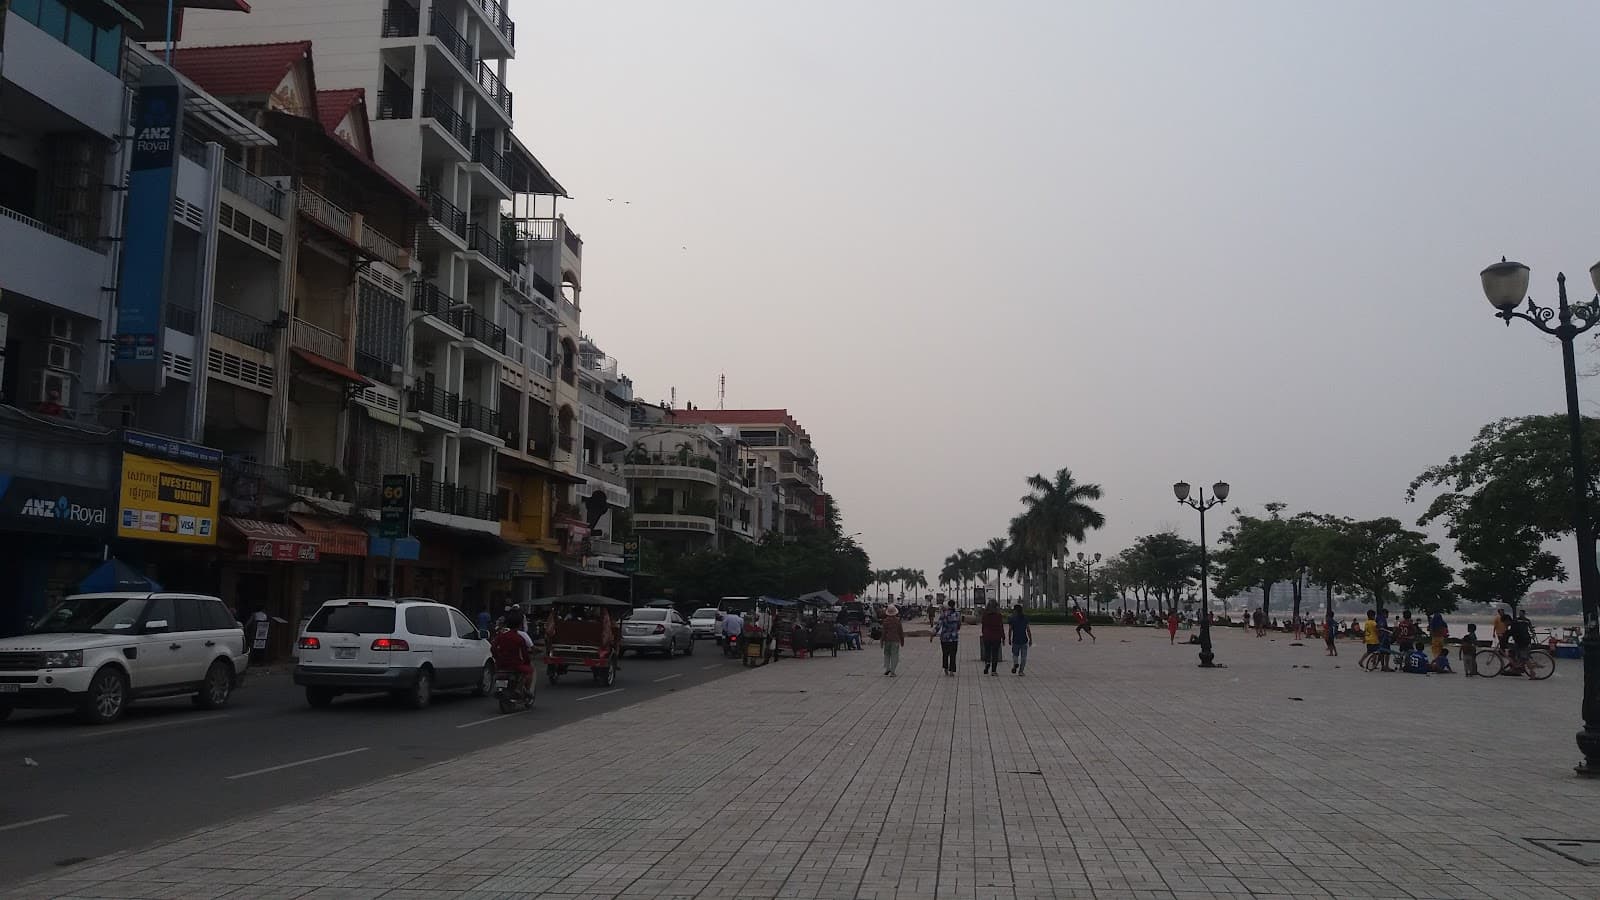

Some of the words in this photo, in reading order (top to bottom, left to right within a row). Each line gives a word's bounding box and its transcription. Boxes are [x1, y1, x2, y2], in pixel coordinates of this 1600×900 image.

[138, 127, 171, 139] ANZ
[137, 140, 170, 154] Royal
[160, 475, 203, 492] WESTERN
[174, 489, 202, 503] UNION
[384, 486, 403, 499] 60
[20, 498, 56, 518] ANZ
[70, 503, 107, 526] Royal
[180, 519, 194, 530] VISA
[624, 542, 638, 551] 60
